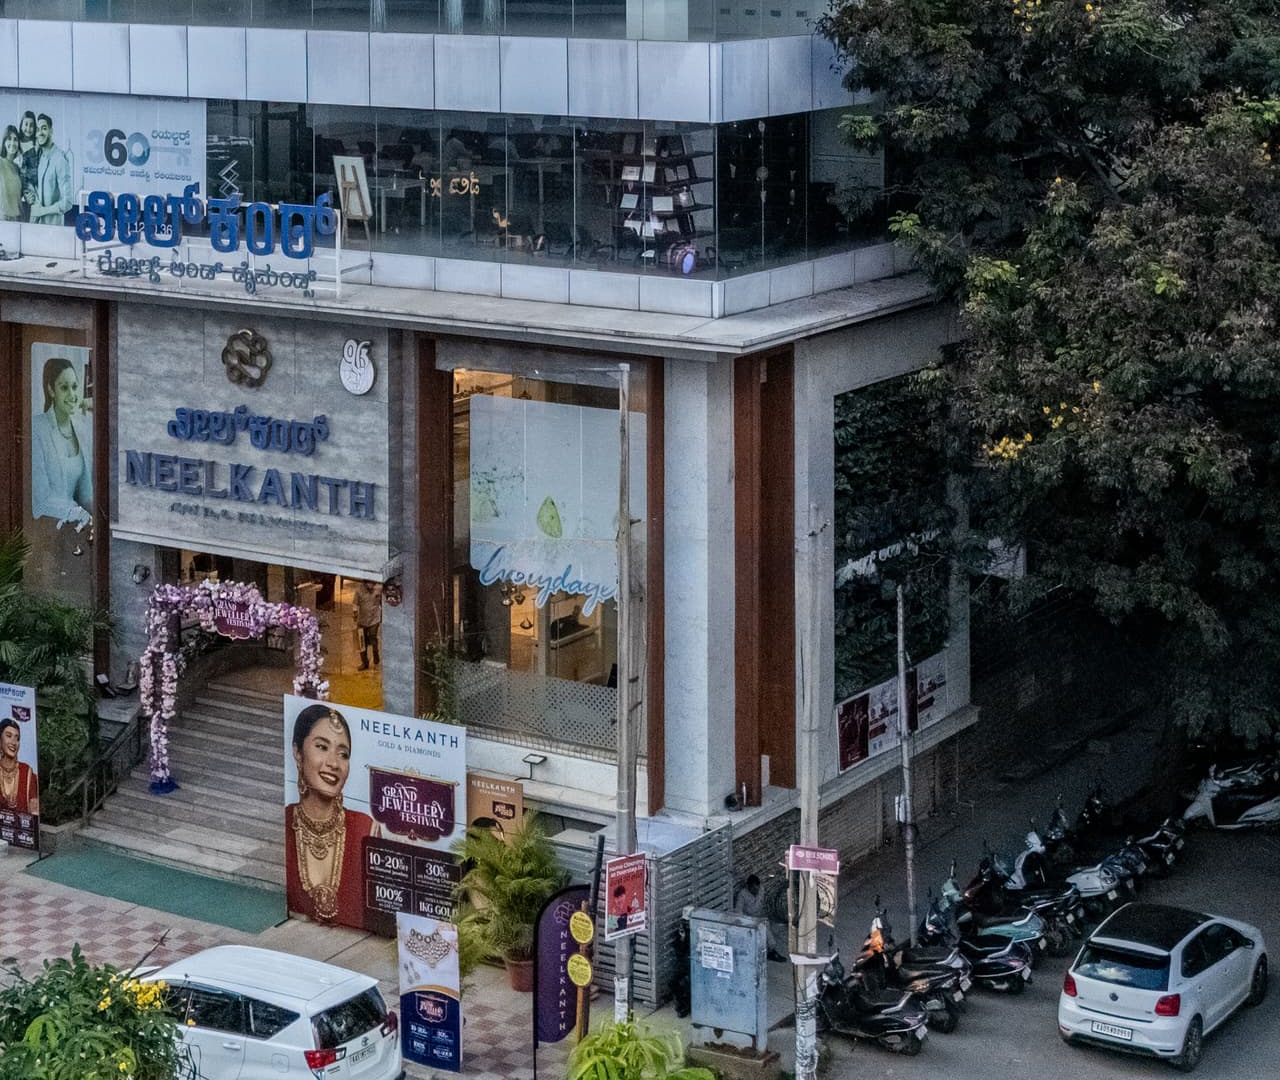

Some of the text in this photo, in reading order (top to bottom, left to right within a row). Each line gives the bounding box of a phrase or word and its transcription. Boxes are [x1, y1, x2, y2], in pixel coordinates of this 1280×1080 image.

[125, 450, 377, 520] NEELKANTH
[360, 719, 459, 749] NEELKANTH
[378, 739, 395, 749] GOLD
[405, 745, 441, 758] DIAMONDS
[381, 782, 418, 802] GRAND
[471, 780, 516, 794] NEELKANTH
[378, 796, 446, 820] JEWELLERY
[401, 811, 444, 832] FESTIVAL
[375, 885, 403, 903] 100%
[559, 930, 568, 1030] NEELKANTH
